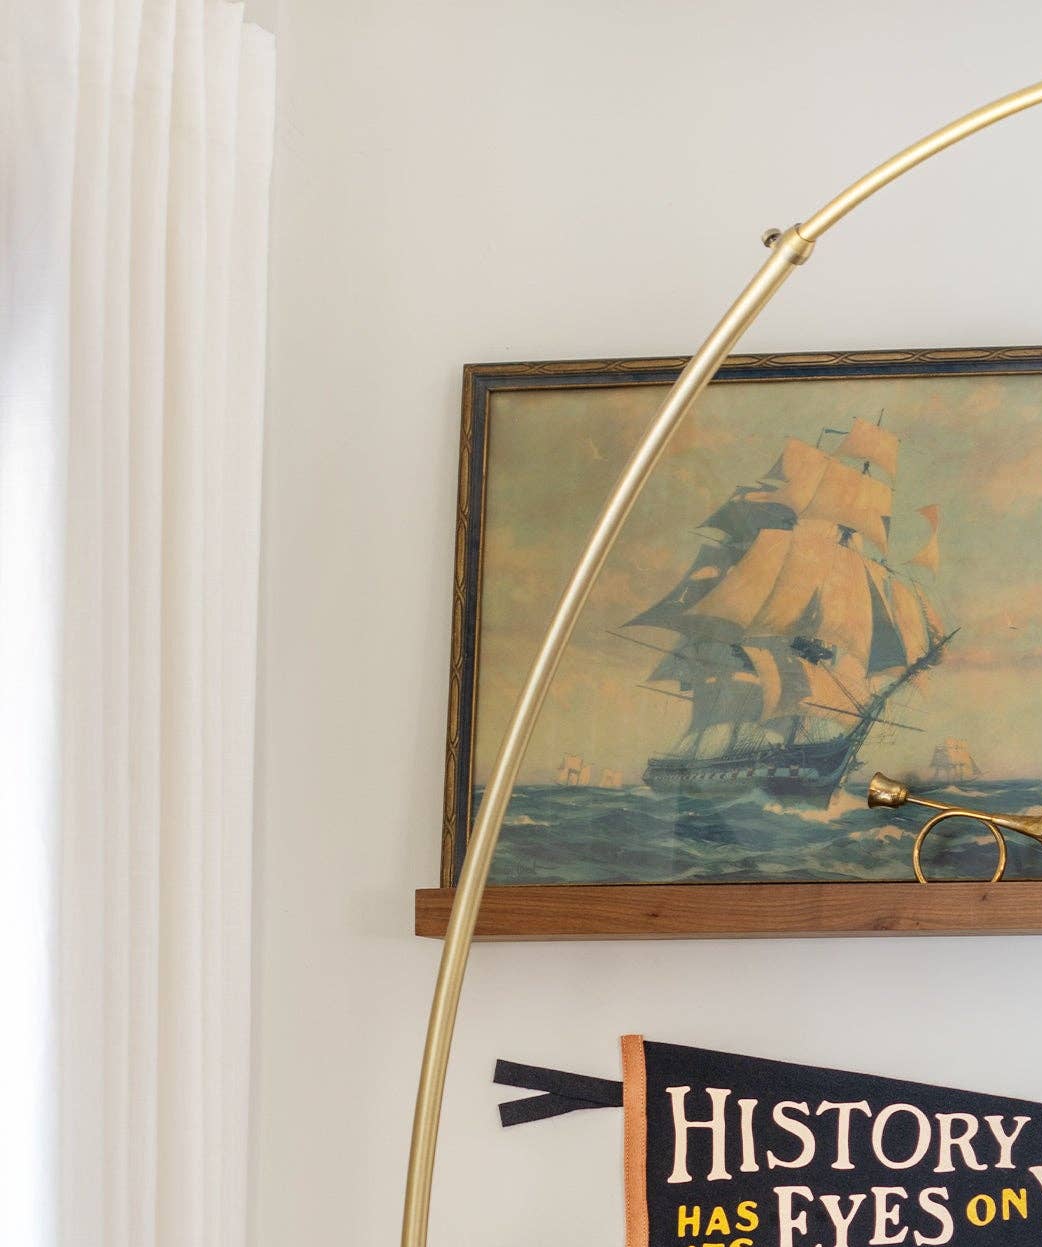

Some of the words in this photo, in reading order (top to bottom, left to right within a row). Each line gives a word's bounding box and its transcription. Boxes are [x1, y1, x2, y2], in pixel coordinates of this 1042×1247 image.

[665, 1086, 1031, 1183] HISTORY
[677, 1200, 760, 1238] HAS
[966, 1187, 1028, 1227] ON
